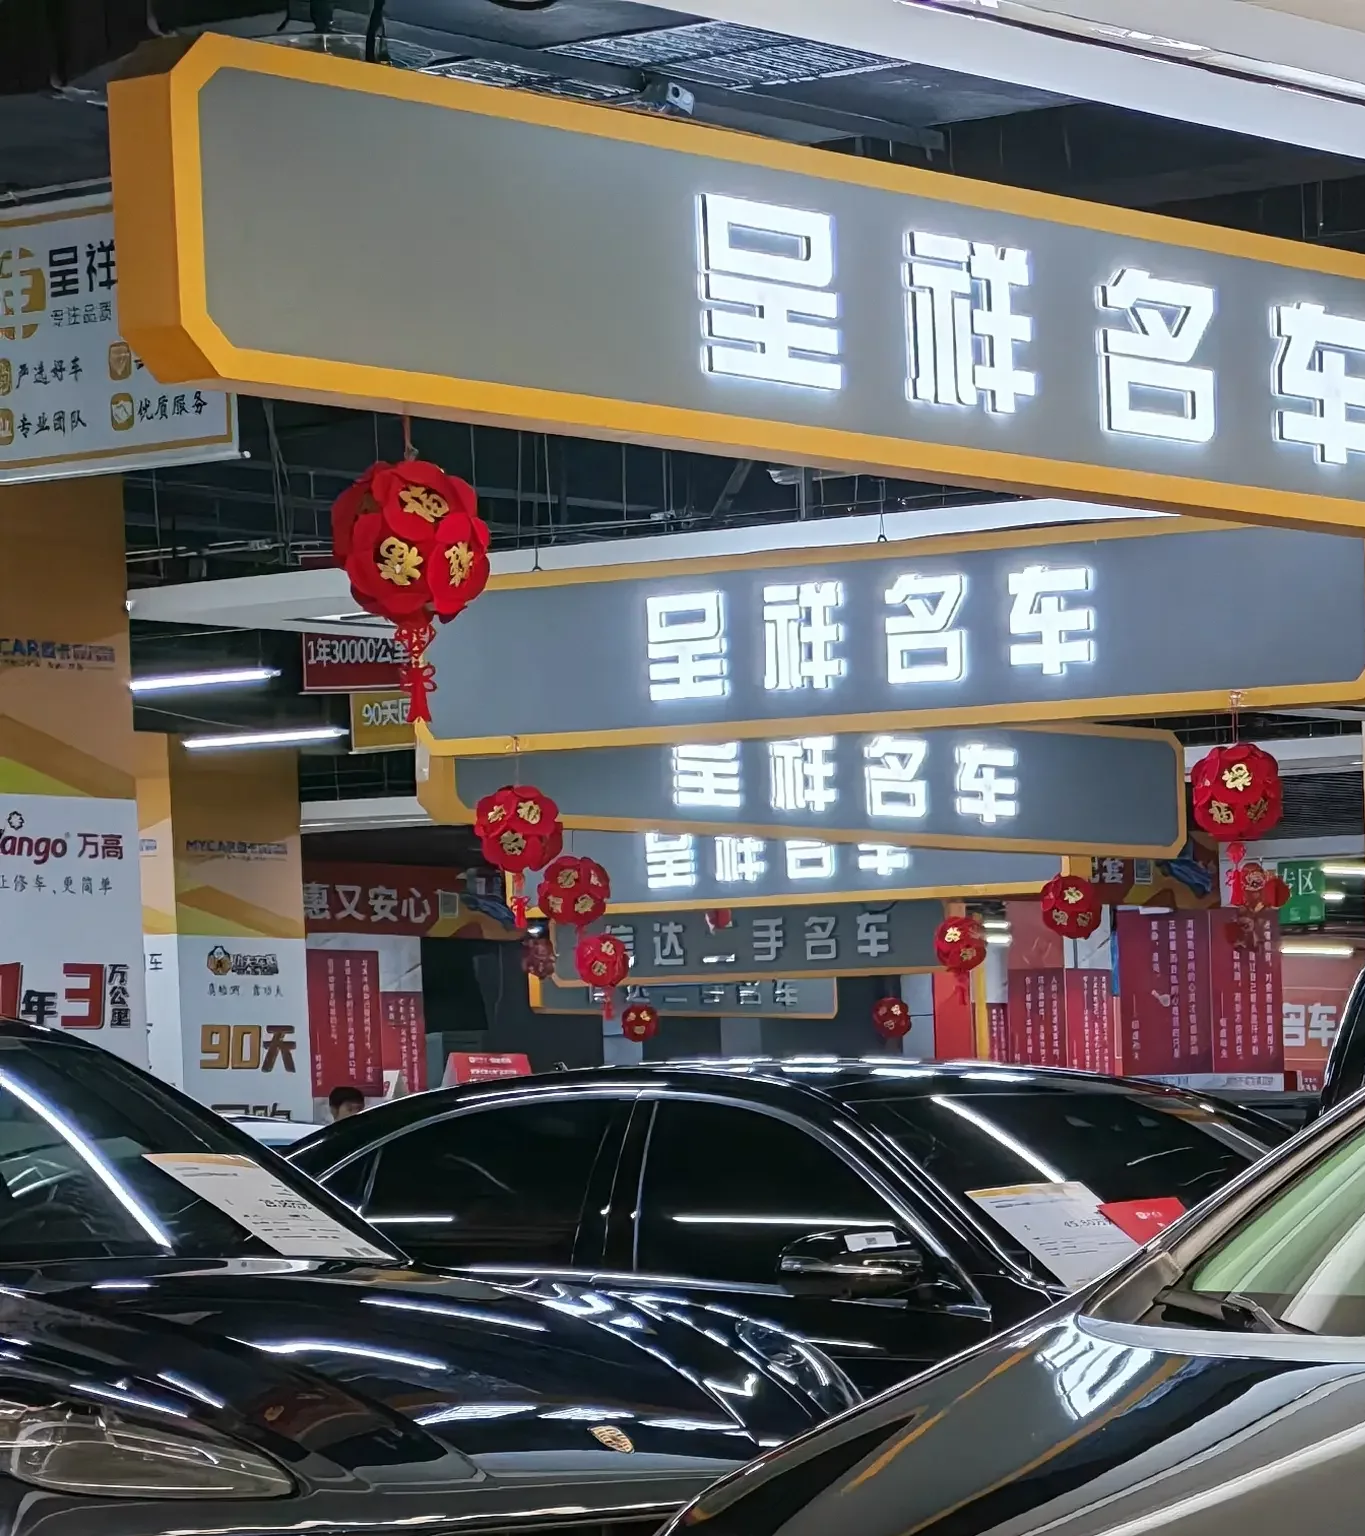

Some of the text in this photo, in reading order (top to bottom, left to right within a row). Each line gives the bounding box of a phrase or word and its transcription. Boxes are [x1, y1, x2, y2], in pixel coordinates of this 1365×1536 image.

[17, 409, 87, 438] 专业团队
[137, 390, 208, 421] 优质服务
[645, 564, 1100, 702] 呈祥名车
[671, 734, 1021, 825] 呈祥名车
[77, 832, 124, 860] 万高
[200, 1024, 297, 1073] 90天
